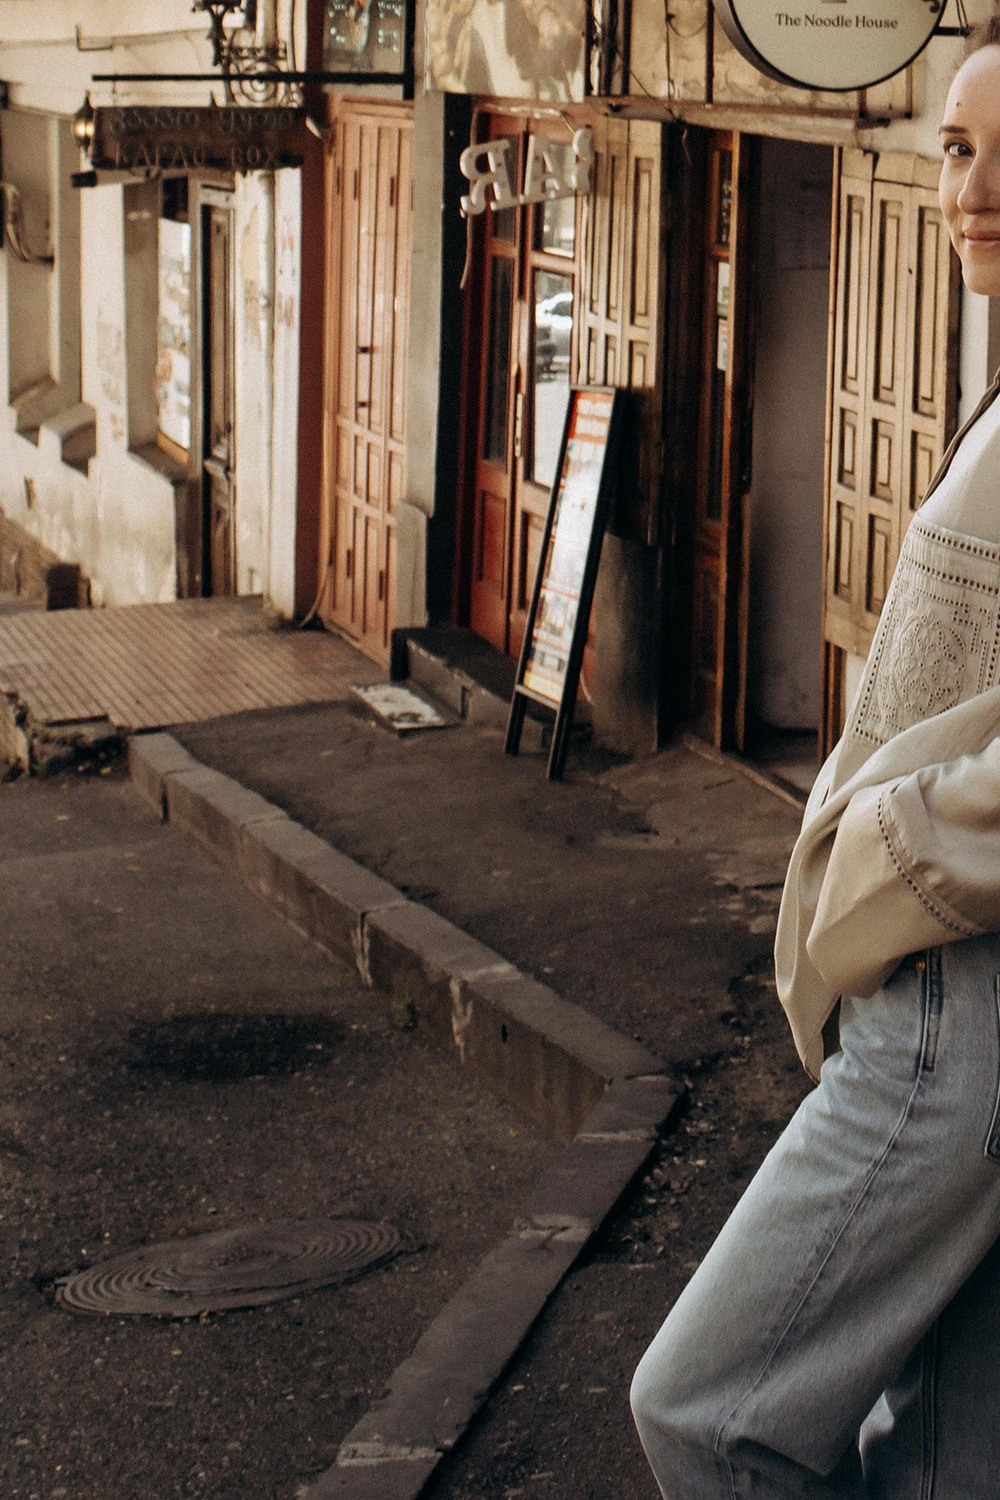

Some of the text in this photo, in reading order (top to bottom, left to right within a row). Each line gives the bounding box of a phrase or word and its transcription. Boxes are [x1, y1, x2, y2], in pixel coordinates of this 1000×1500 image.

[775, 13, 898, 29] The Noodle House
